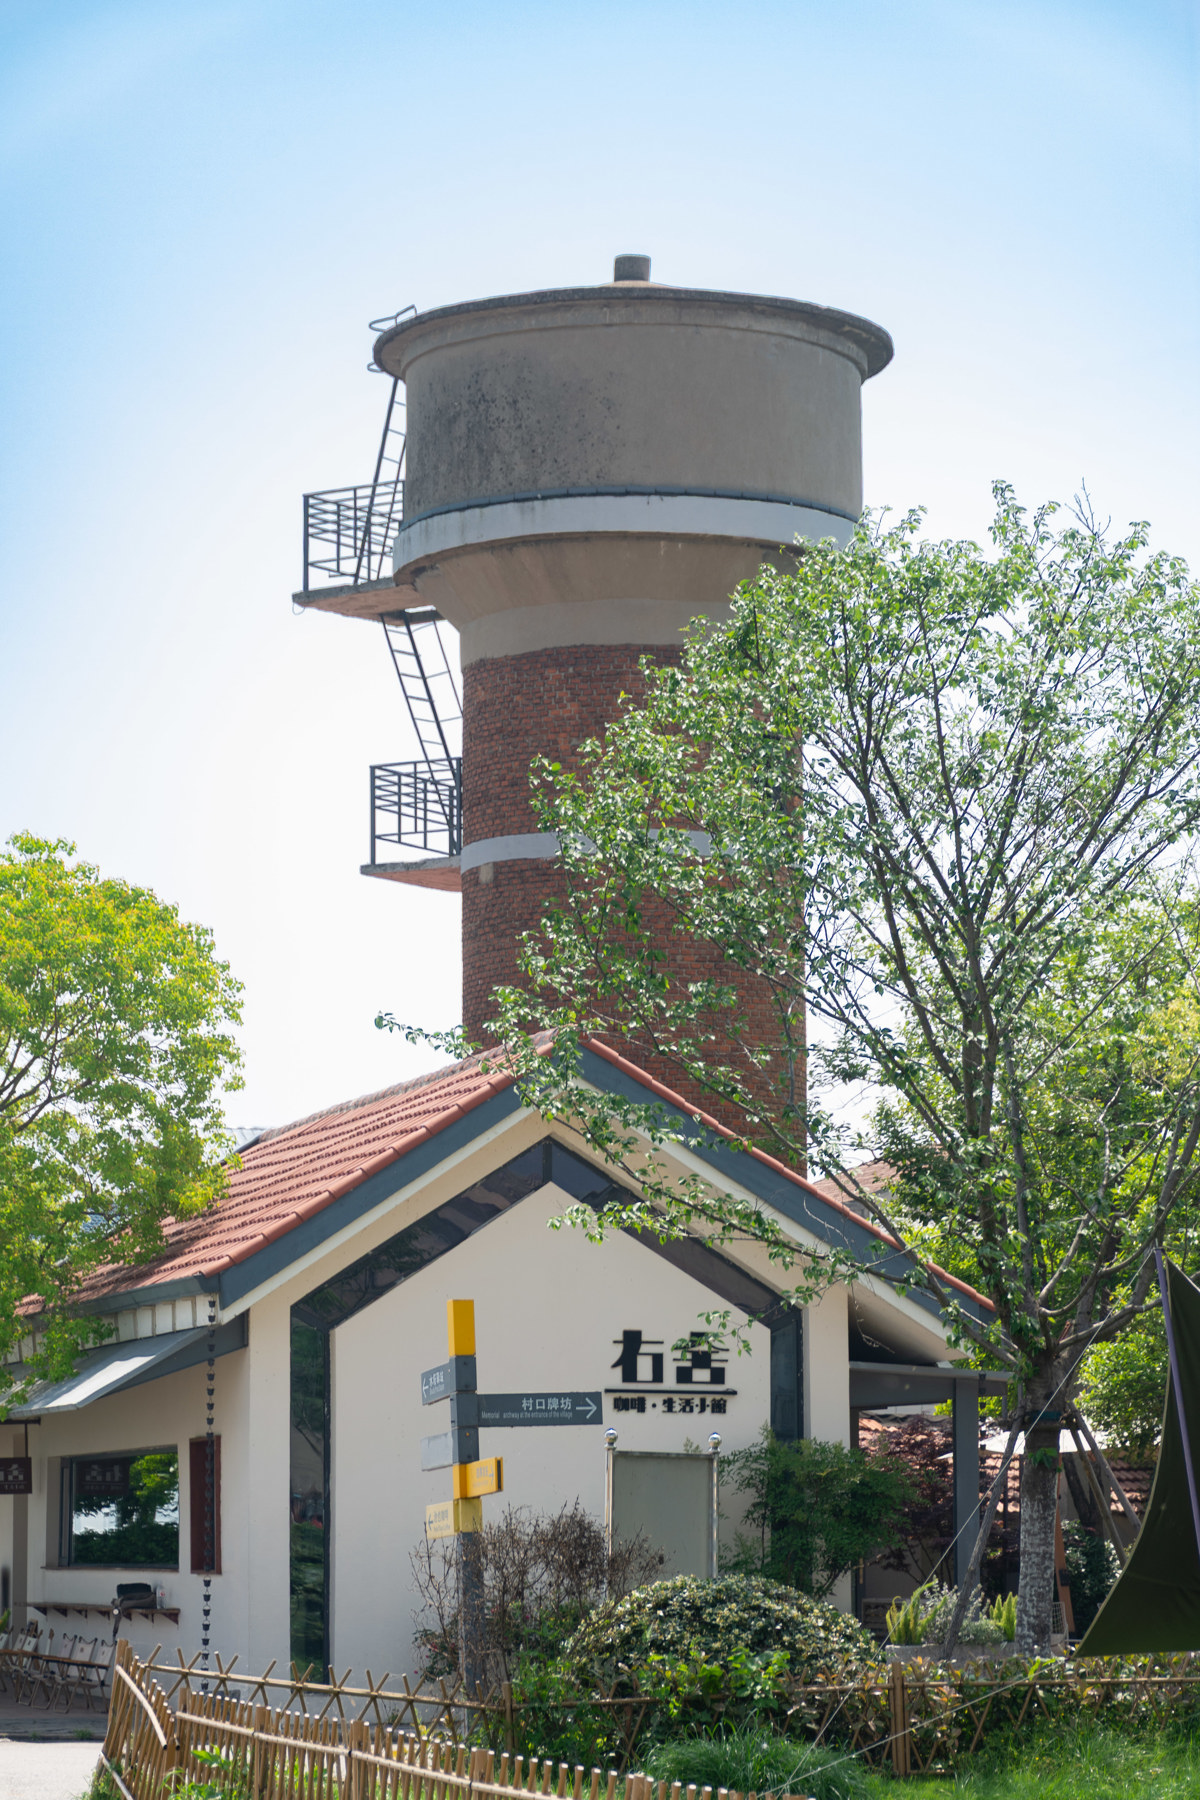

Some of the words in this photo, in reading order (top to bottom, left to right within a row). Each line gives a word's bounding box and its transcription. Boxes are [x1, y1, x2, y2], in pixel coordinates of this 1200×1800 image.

[611, 1330, 729, 1384] 右舍
[522, 1397, 572, 1410] 村口牌坊
